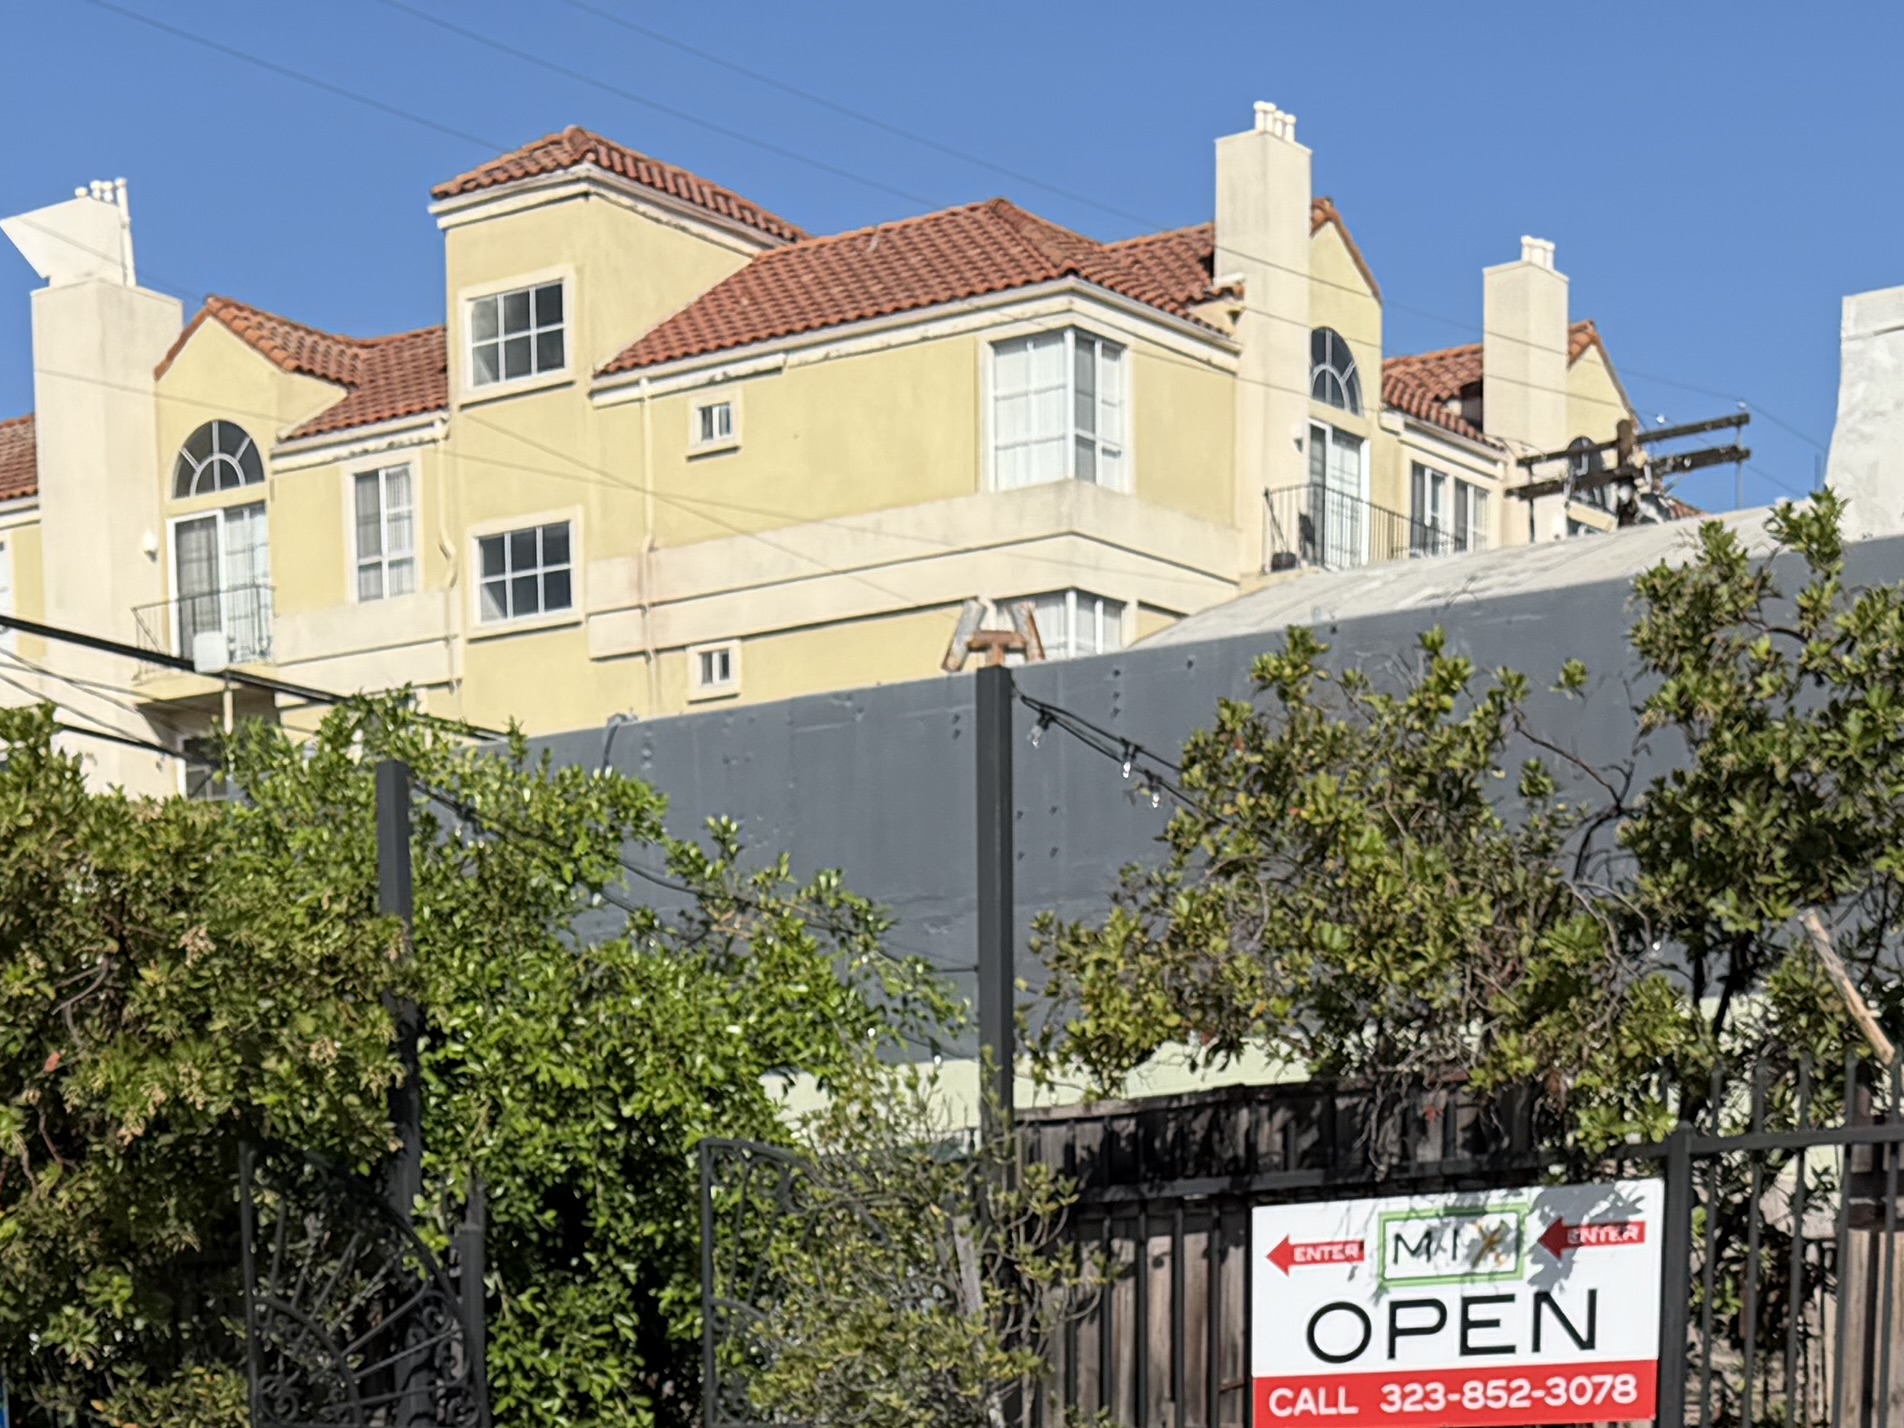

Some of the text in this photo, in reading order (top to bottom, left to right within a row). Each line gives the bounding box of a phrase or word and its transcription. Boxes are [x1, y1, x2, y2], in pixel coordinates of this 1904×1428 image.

[1294, 1243, 1361, 1262] ENTER
[1393, 1220, 1508, 1267] MIX
[1567, 1223, 1640, 1245] ENTER
[1306, 1288, 1598, 1363] OPEN
[1268, 1373, 1638, 1417] CALL 323-852-3078
